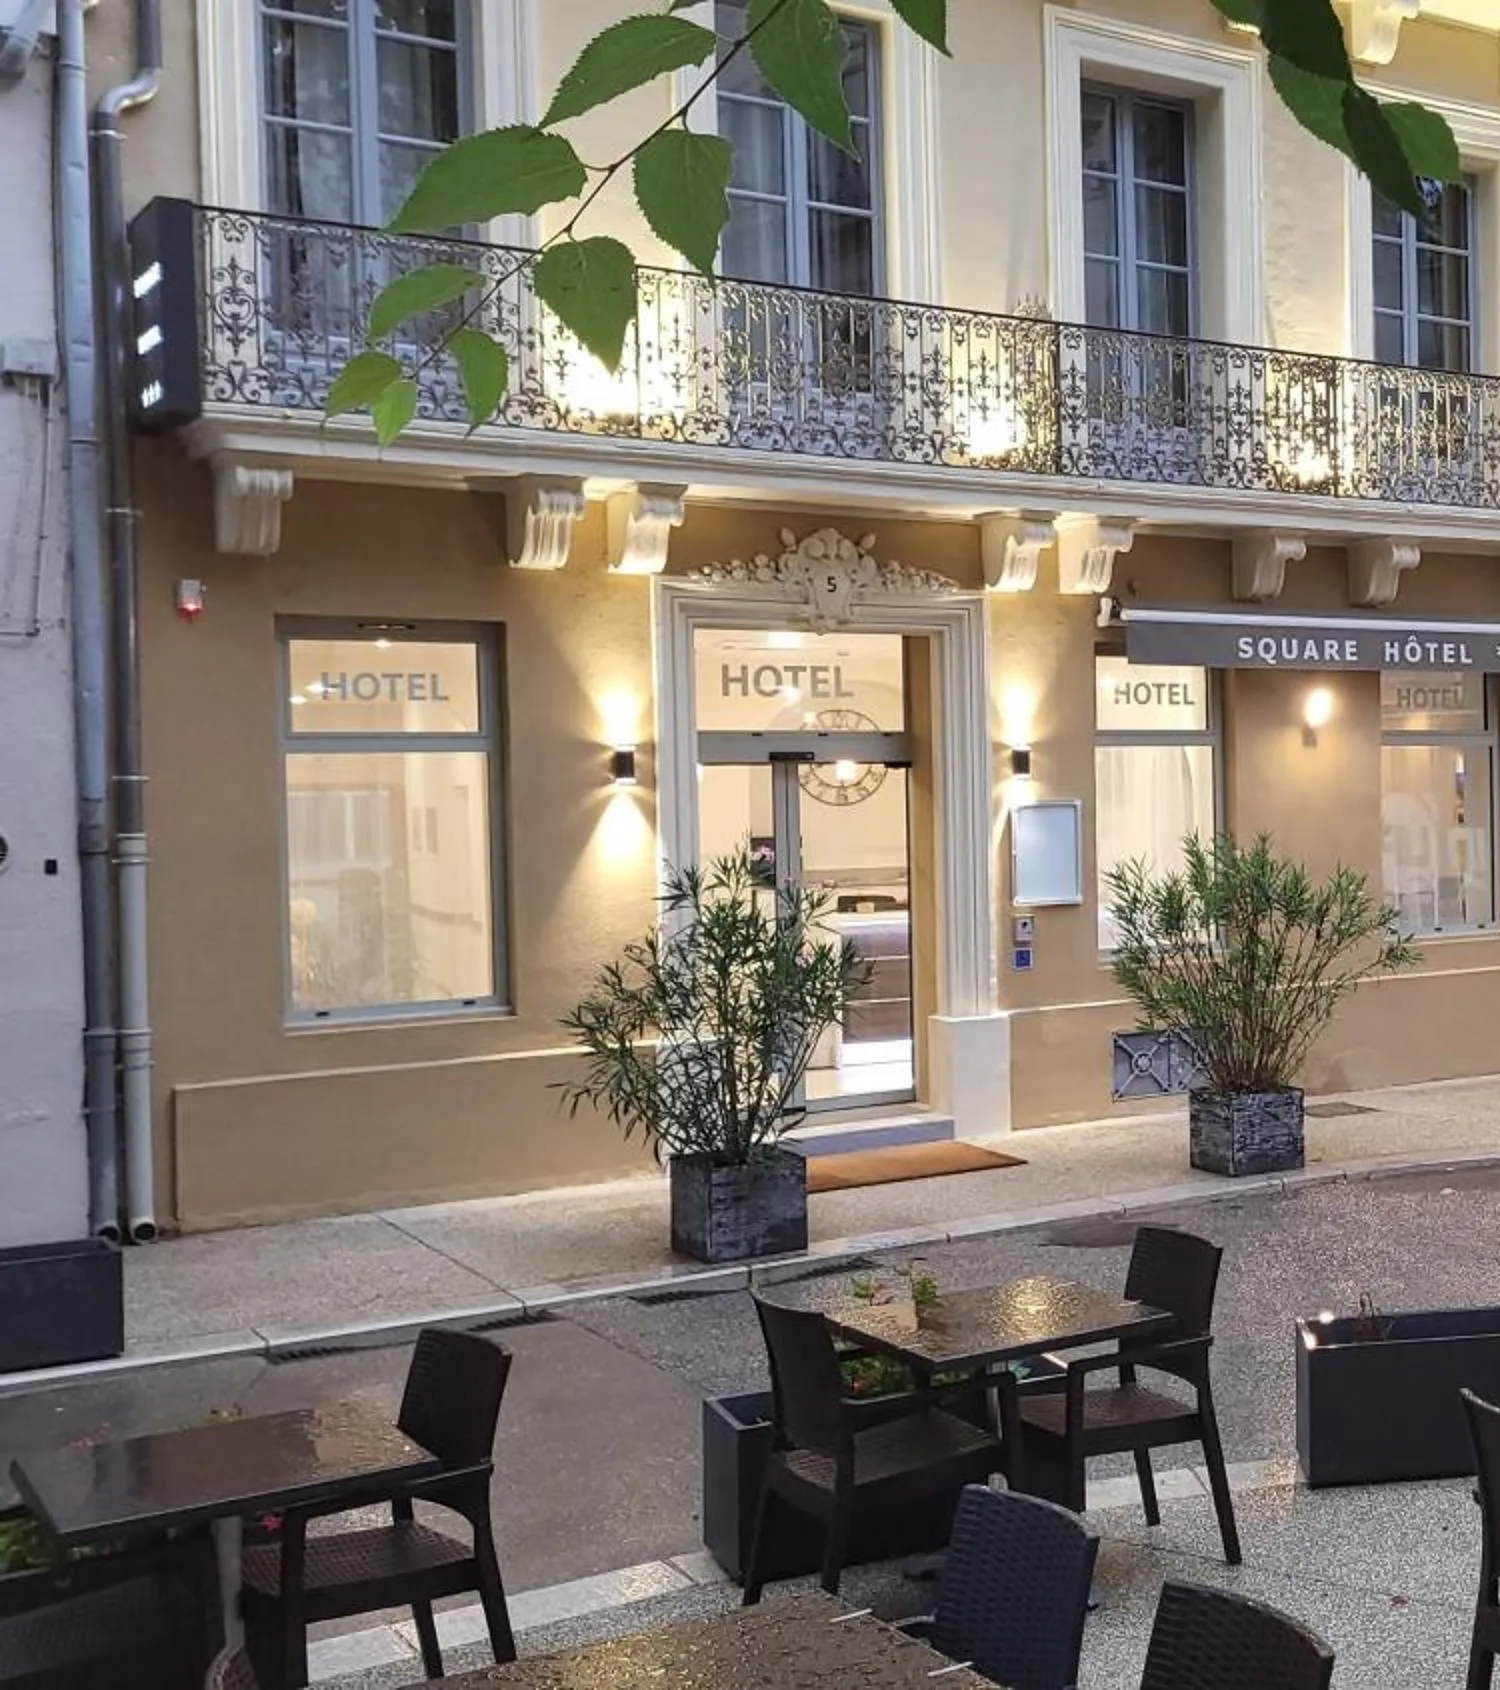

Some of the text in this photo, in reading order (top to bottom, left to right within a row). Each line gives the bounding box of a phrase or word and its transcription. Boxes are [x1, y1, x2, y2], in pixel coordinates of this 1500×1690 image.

[827, 576, 837, 593] 5
[1237, 635, 1473, 665] SQUARE HÔTEL
[320, 672, 449, 701] HOTEL
[720, 663, 854, 698] HOTEL
[1114, 682, 1196, 706] HOTEL
